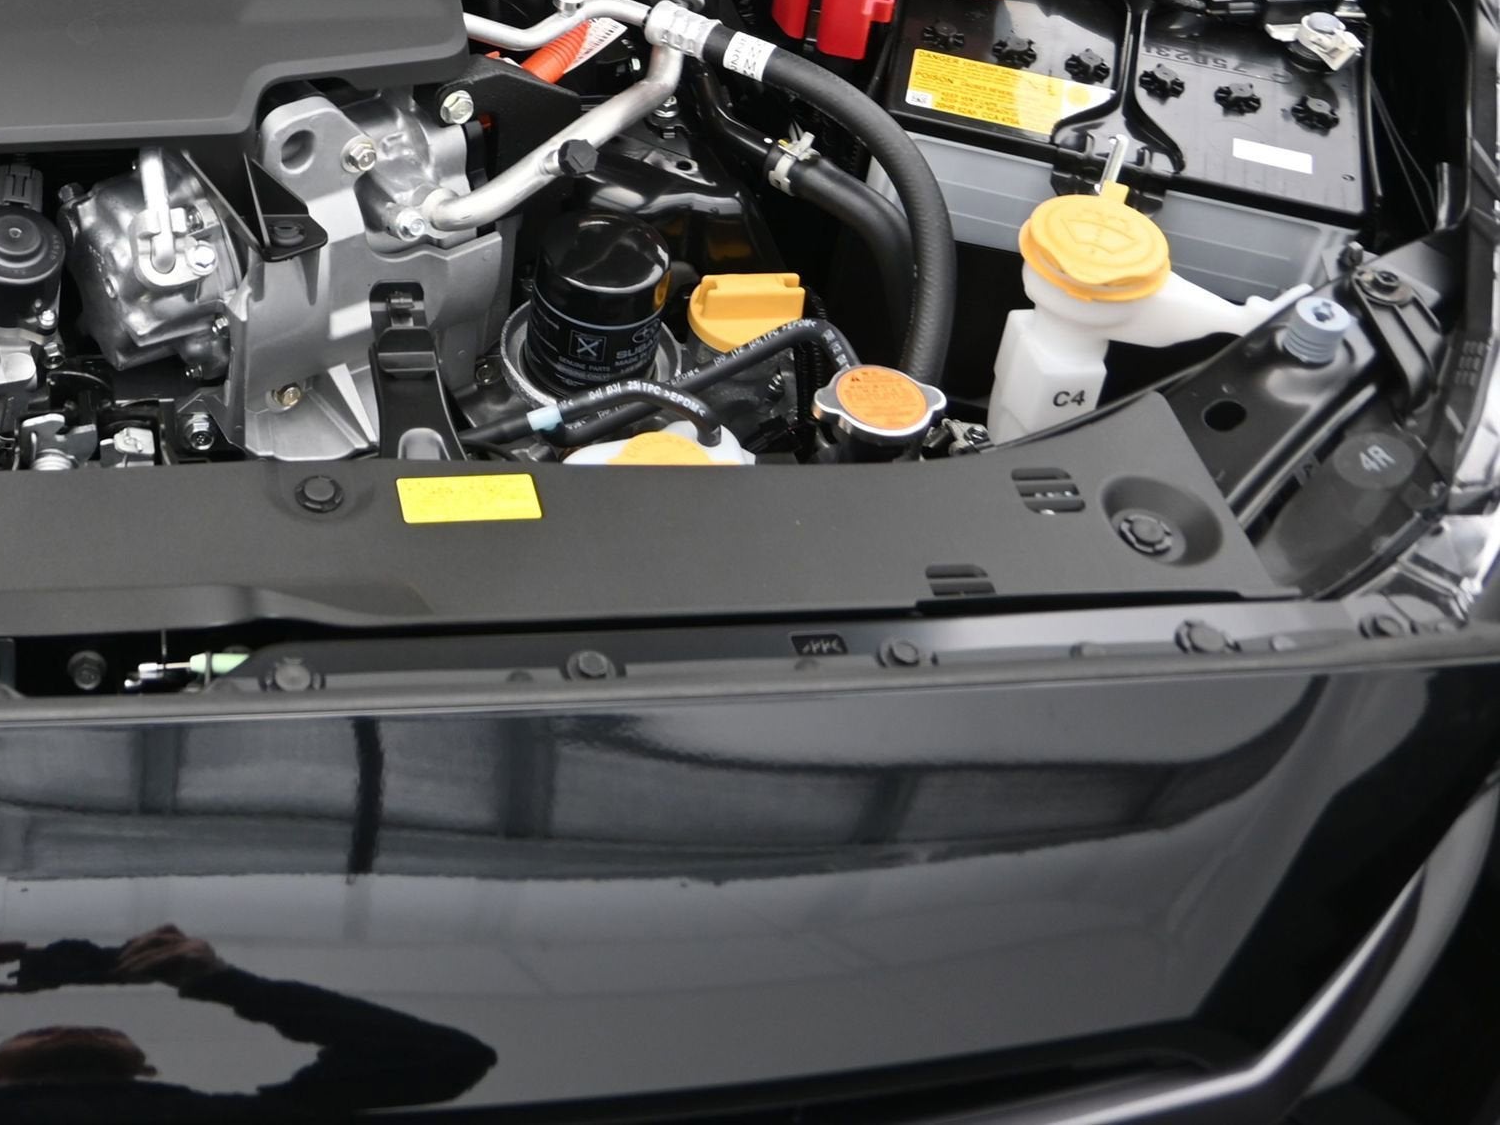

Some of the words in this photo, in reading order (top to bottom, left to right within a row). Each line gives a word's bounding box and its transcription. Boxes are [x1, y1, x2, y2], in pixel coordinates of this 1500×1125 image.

[918, 51, 959, 65] DANGER
[1052, 389, 1085, 407] C4
[1360, 444, 1397, 472] 4R
